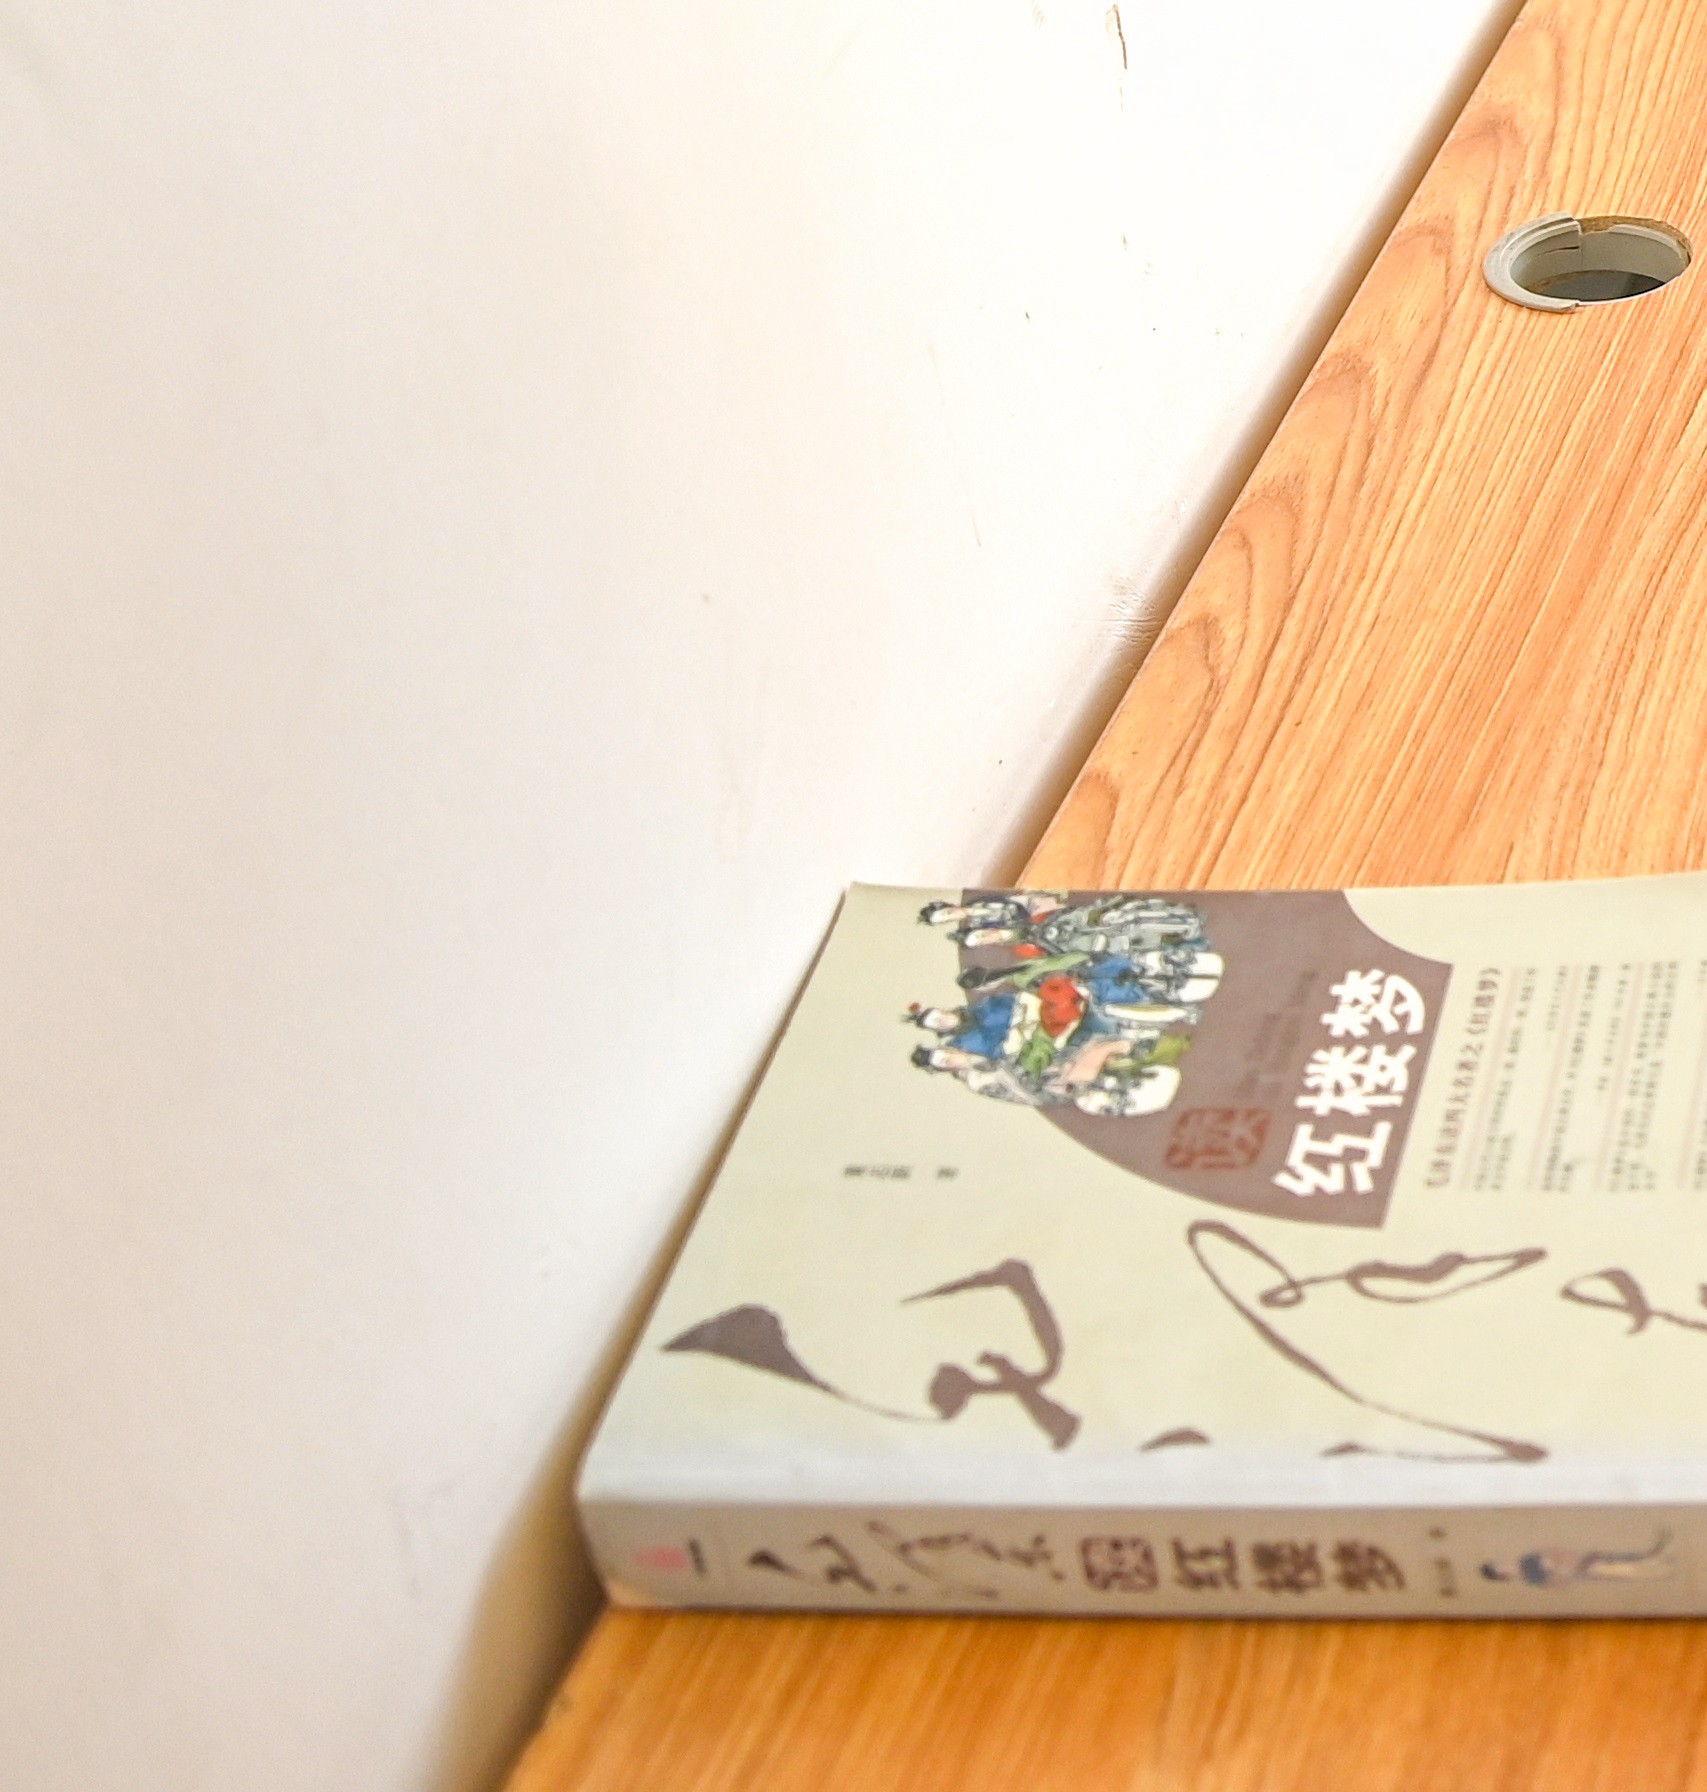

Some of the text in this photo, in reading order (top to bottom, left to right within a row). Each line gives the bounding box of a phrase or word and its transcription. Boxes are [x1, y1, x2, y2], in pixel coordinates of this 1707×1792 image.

[1271, 968, 1426, 1196] 红楼梦
[1171, 1536, 1407, 1597] 红楼梦
